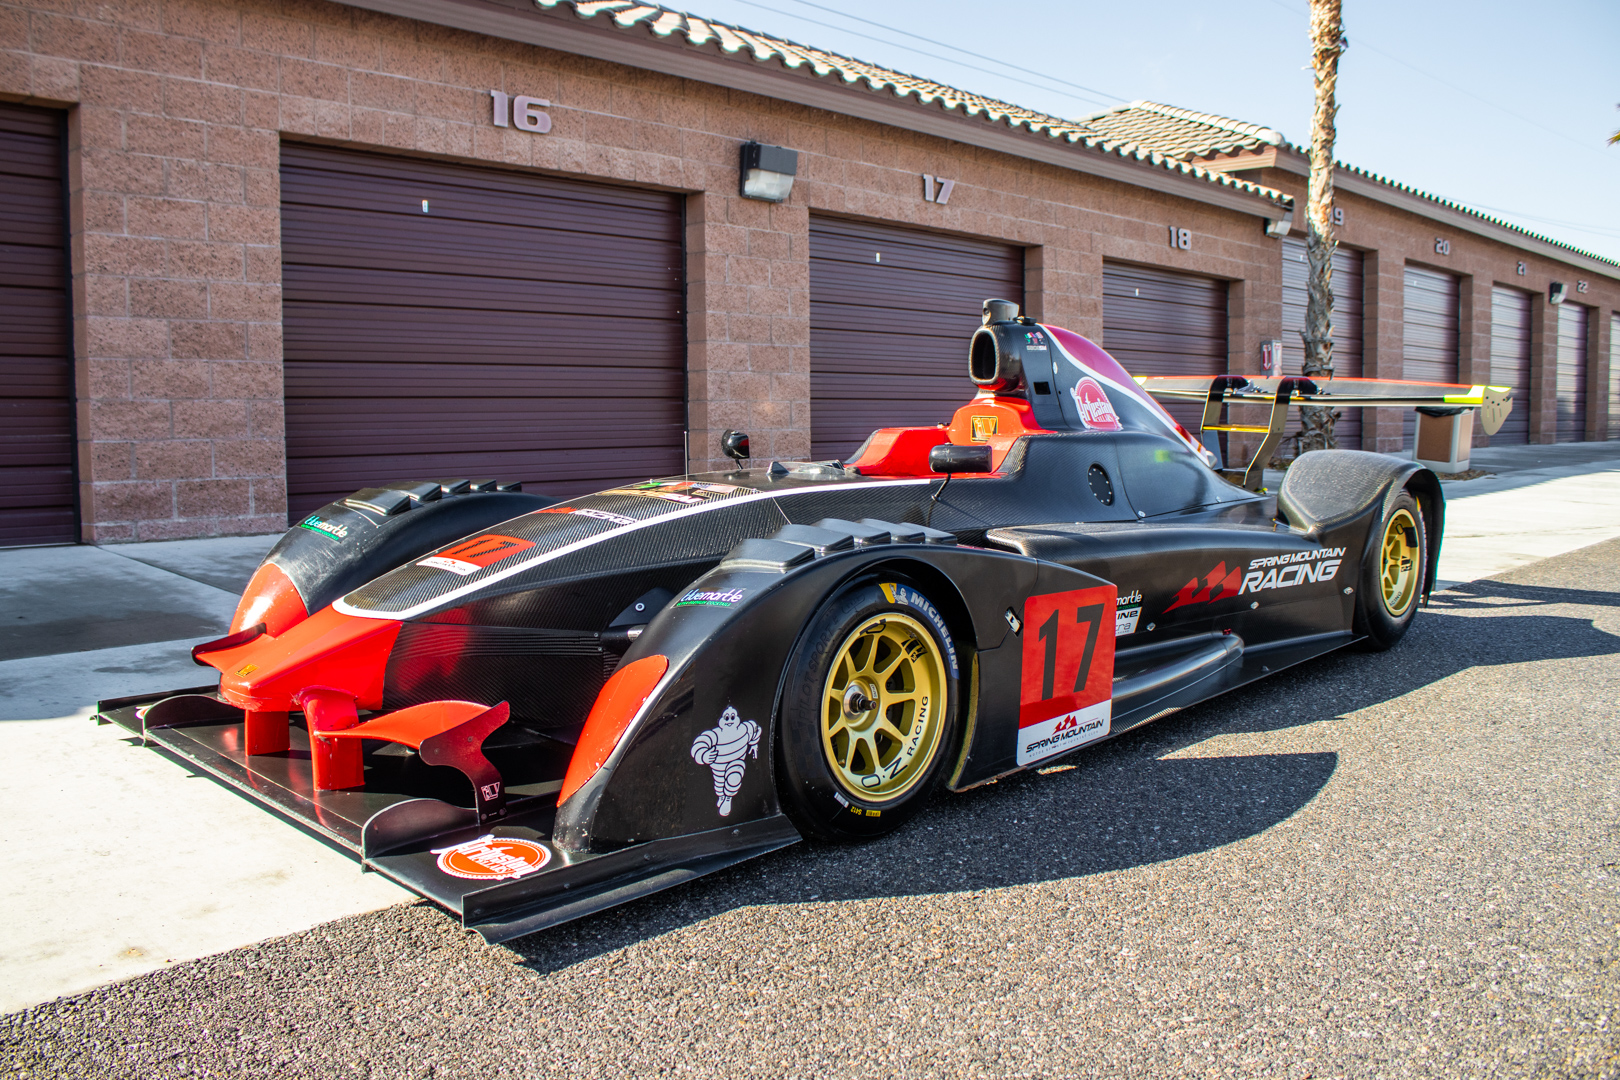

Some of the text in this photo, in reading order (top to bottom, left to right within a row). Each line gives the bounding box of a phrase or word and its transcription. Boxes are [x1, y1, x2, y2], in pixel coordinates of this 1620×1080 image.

[490, 90, 552, 134] 16
[922, 173, 955, 204] 17
[1169, 226, 1192, 250] 18
[1435, 237, 1449, 255] 20
[1577, 280, 1588, 294] 22
[1248, 547, 1346, 570] SPRING MOUNTAIN
[1238, 559, 1342, 595] RACING
[1116, 589, 1143, 606] marble
[910, 592, 958, 669] MICHELIN
[1038, 602, 1106, 701] 17
[906, 696, 929, 757] RACING
[1026, 733, 1060, 753] SPRING
[1060, 719, 1104, 742] MOUNTAIN
